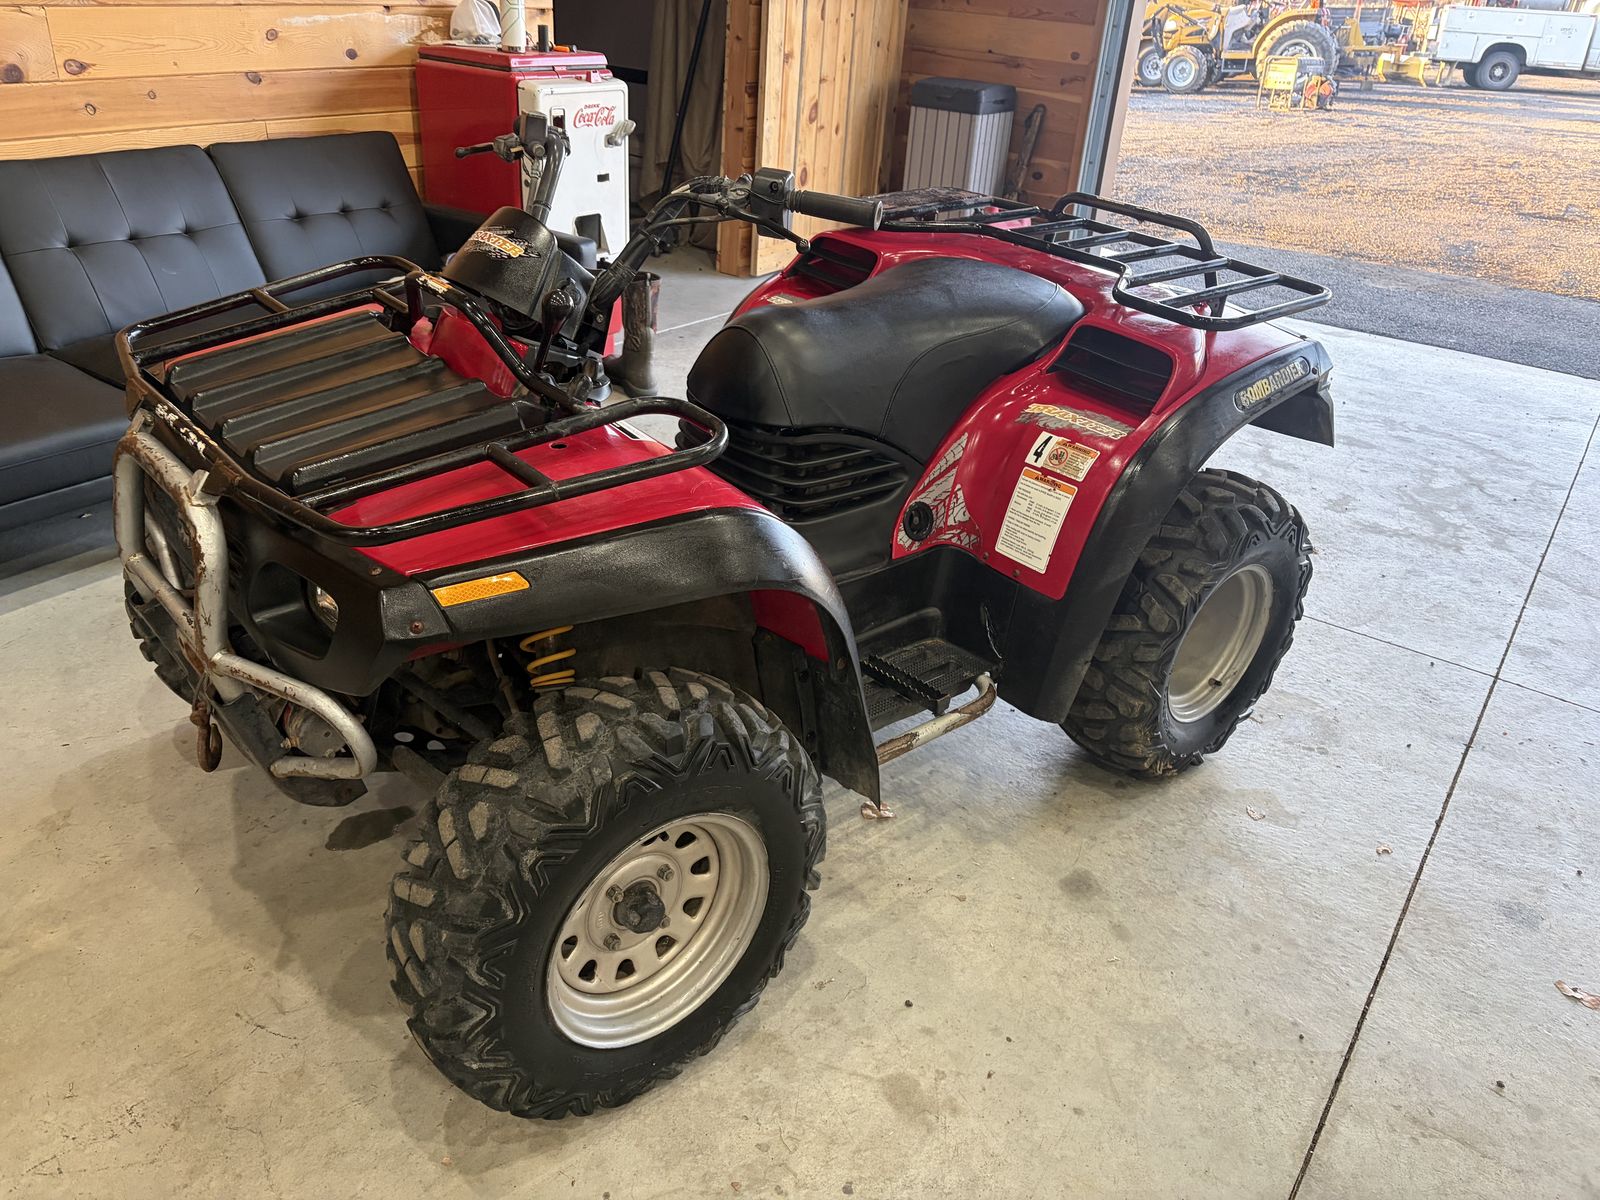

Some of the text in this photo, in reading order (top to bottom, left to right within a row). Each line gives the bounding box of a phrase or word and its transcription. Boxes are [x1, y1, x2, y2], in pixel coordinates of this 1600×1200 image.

[573, 106, 616, 128] Coca-Cola
[1239, 360, 1305, 407] BOMBARDIER
[1024, 403, 1128, 440] TRAXTER
[1033, 435, 1053, 463] 4
